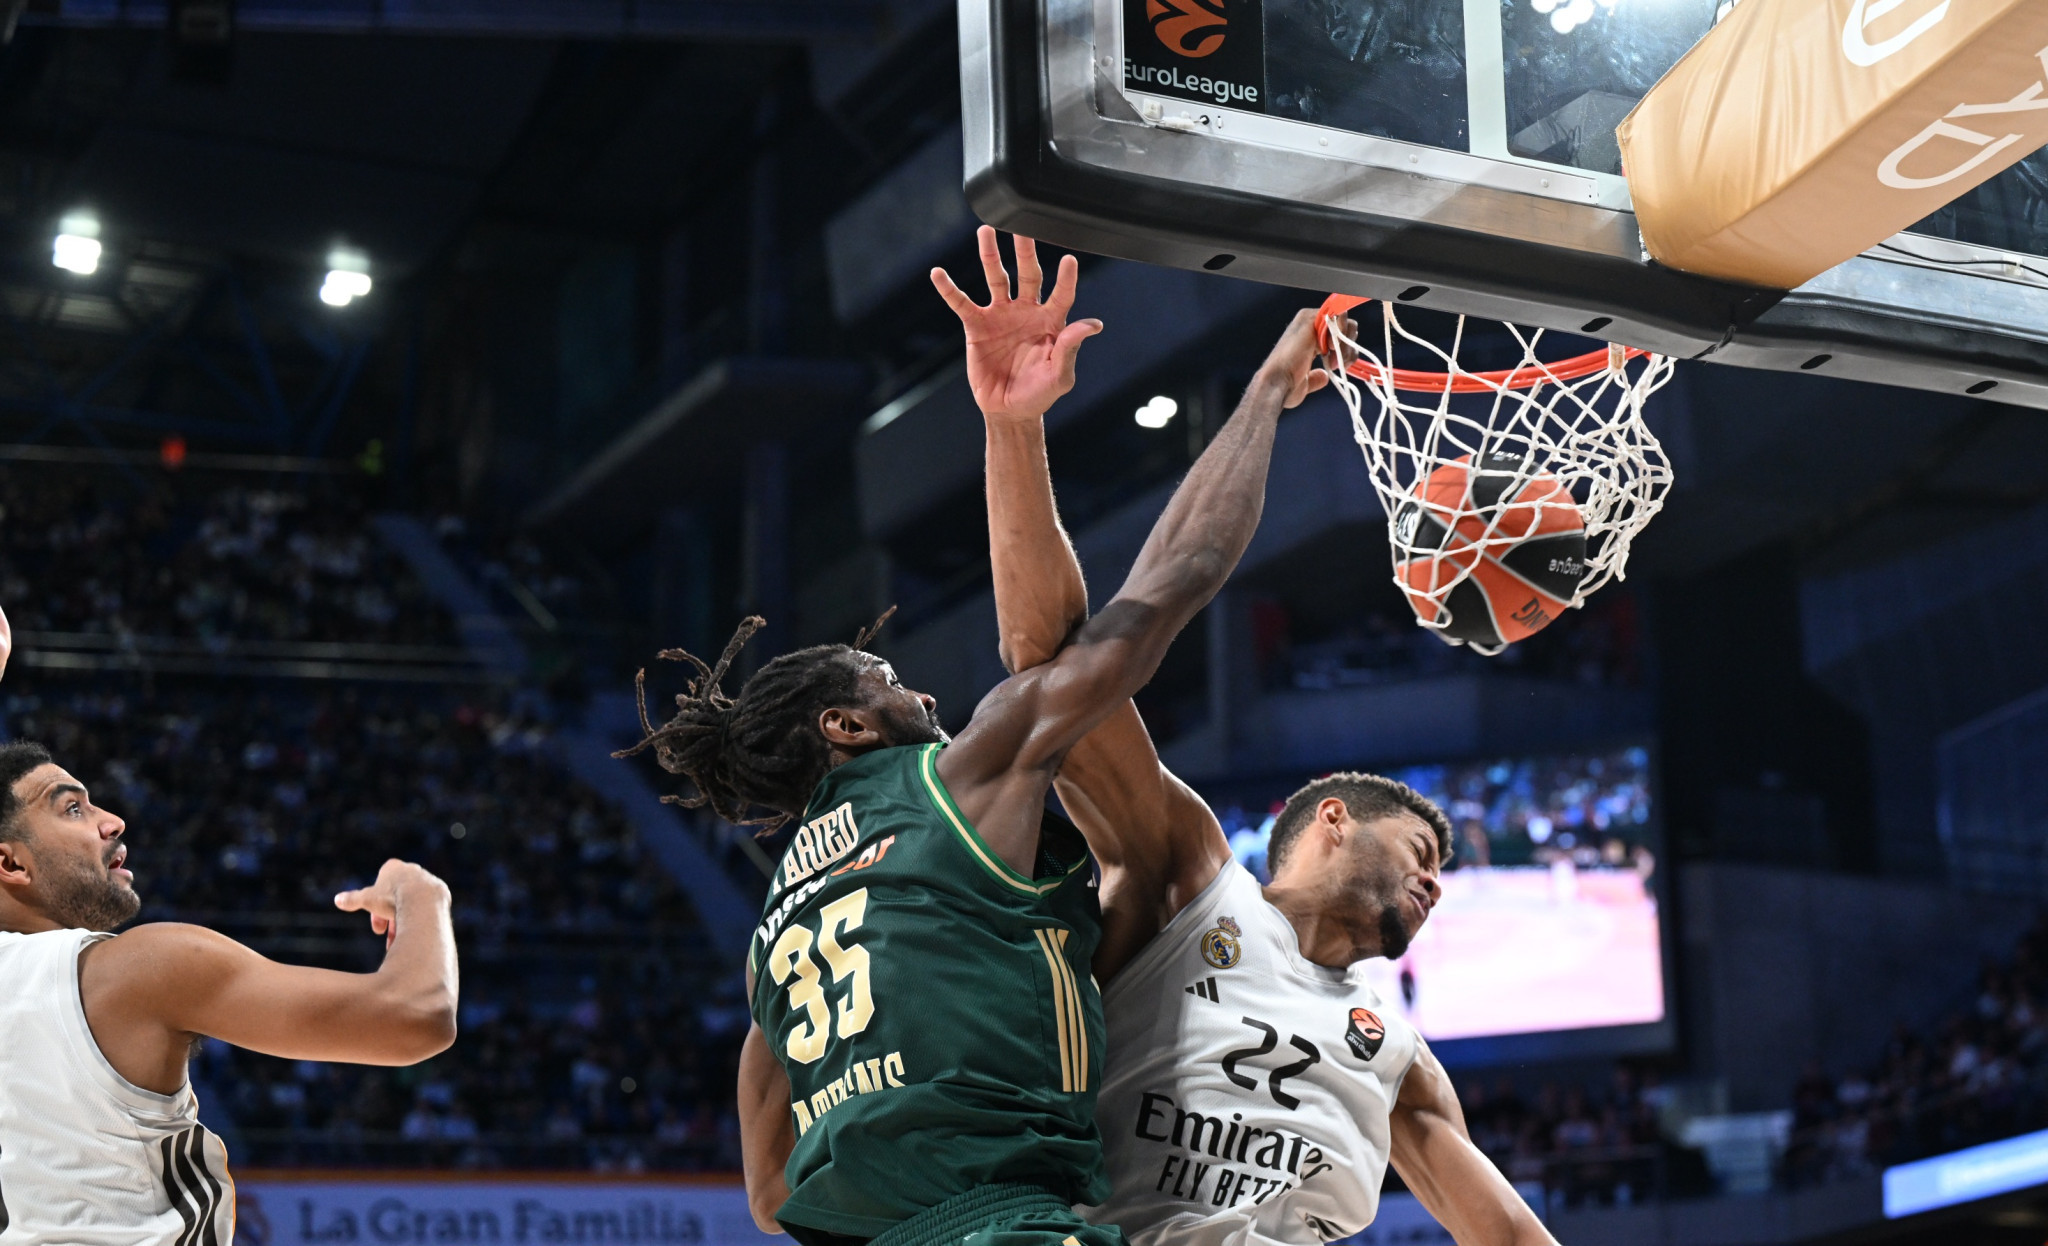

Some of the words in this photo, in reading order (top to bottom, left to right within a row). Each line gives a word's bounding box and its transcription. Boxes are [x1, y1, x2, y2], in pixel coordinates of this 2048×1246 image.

[1125, 57, 1258, 104] EuroLeague
[769, 886, 875, 1065] 35
[1221, 1016, 1321, 1111] 22
[1135, 1092, 1333, 1181] Emirates
[1156, 1155, 1209, 1200] FLY
[297, 1199, 358, 1243] La
[368, 1198, 501, 1243] Gran
[512, 1197, 705, 1243] Familia
